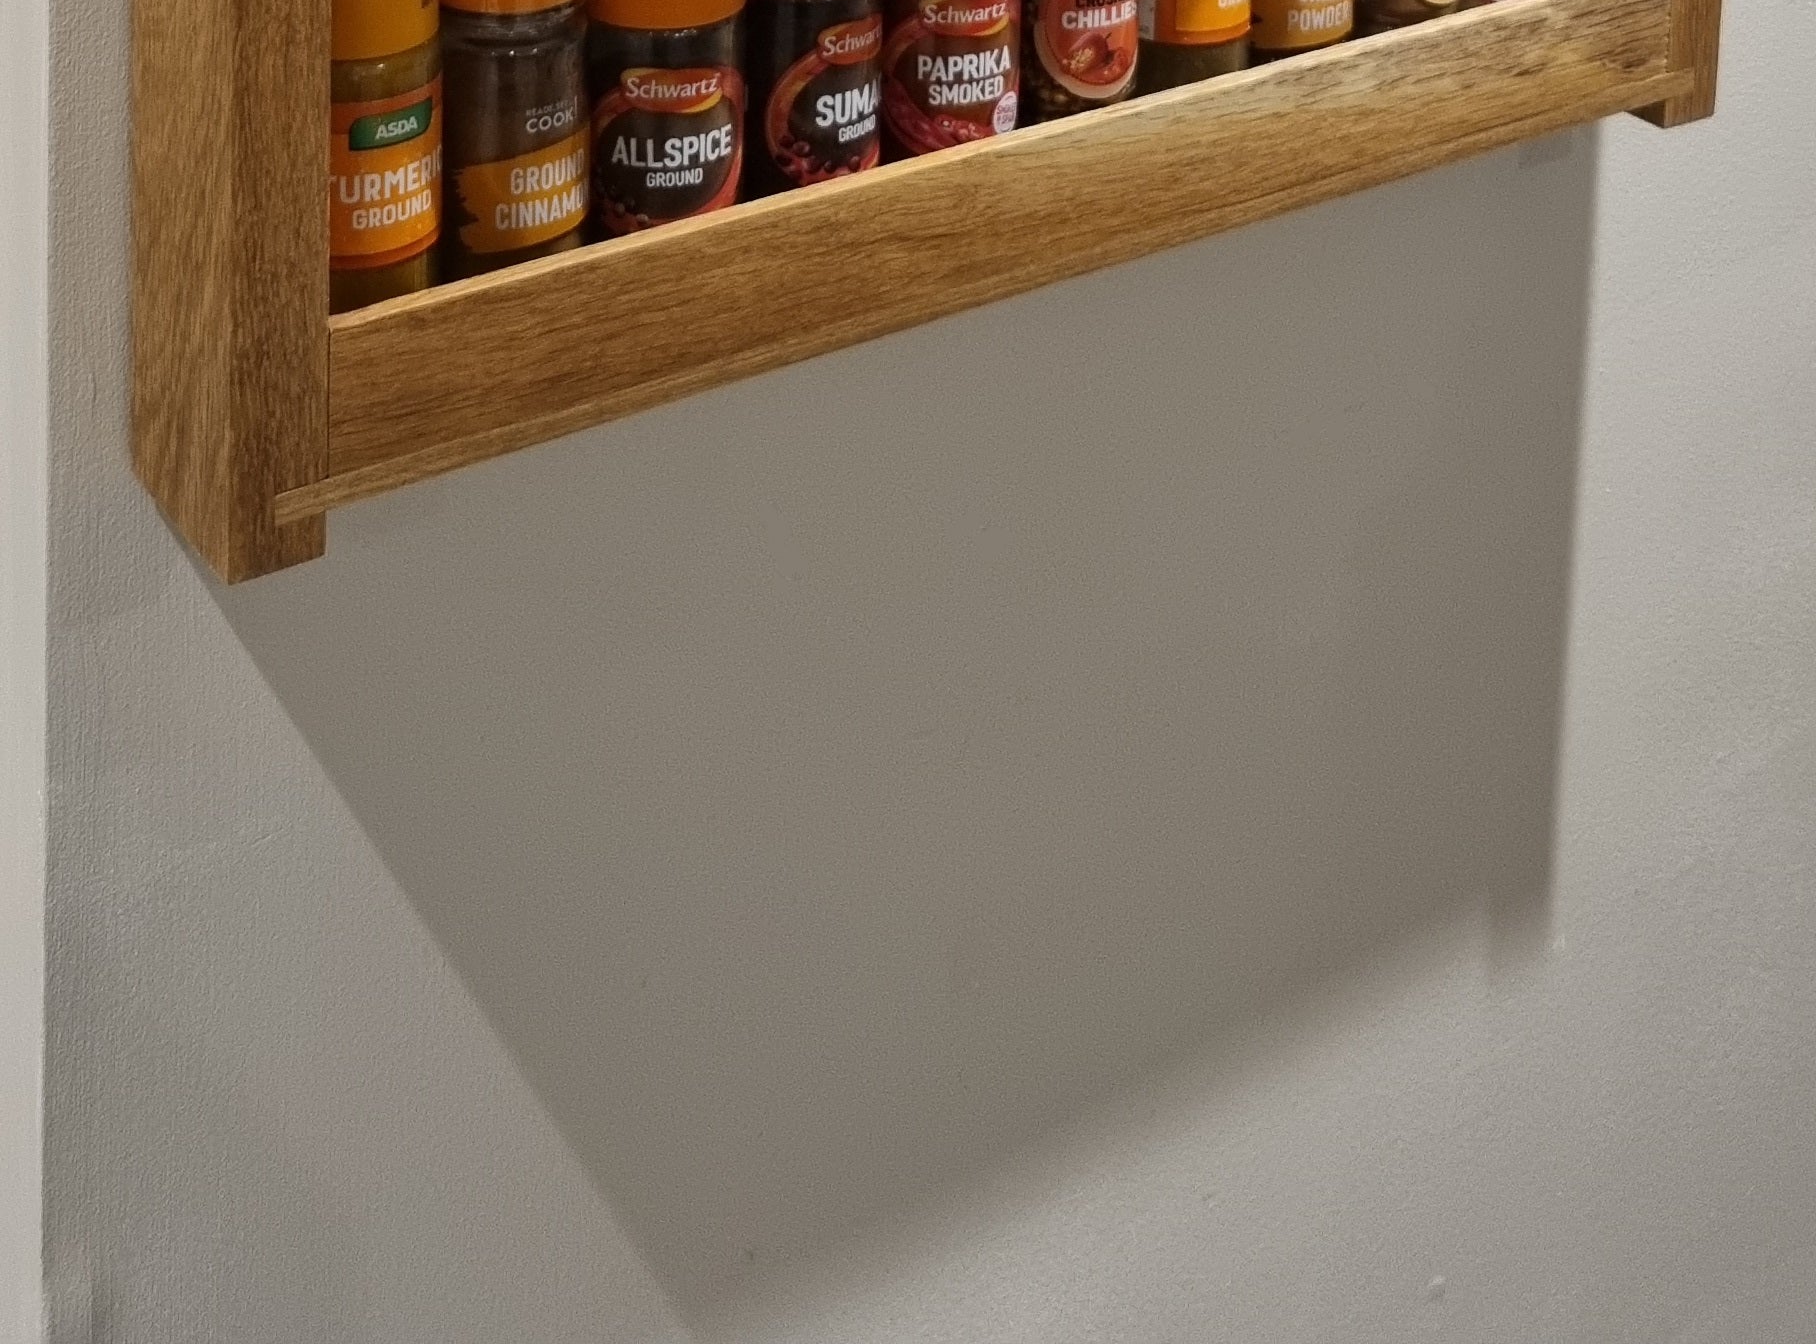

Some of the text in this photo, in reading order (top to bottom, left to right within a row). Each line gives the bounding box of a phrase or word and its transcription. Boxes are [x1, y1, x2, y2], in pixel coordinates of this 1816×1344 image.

[923, 2, 1007, 25] Schwartz
[1287, 1, 1350, 32] POWDER
[917, 45, 1011, 83] PAPRIKA
[625, 76, 718, 99] Schwartz
[929, 75, 1004, 107] SMOKED
[375, 116, 418, 140] ASDA
[526, 96, 577, 134] COOK!
[838, 114, 876, 143] GROUND
[612, 123, 733, 168] ALLSPICE
[510, 149, 585, 196] GROUND
[646, 168, 704, 188] GROUND
[353, 190, 432, 230] GROUND
